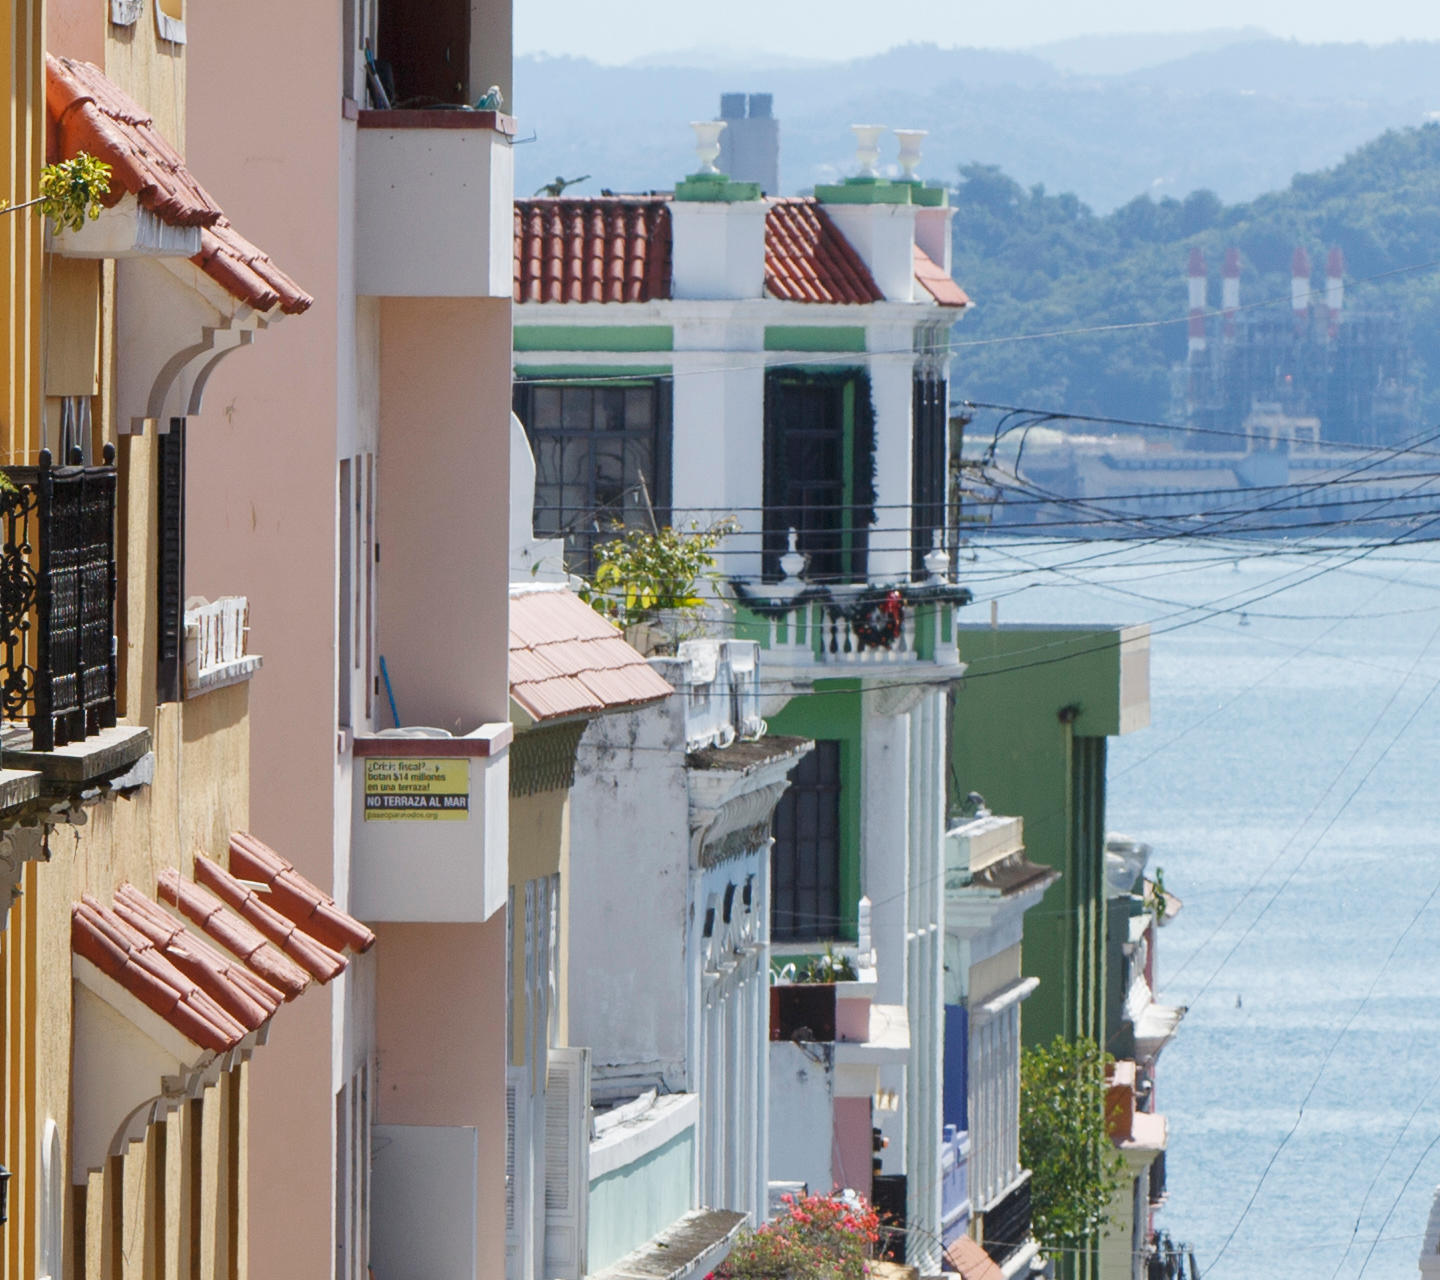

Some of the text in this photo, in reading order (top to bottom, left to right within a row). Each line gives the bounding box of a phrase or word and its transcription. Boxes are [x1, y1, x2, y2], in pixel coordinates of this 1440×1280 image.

[393, 772, 408, 782] $14
[411, 773, 446, 781] millones
[367, 782, 430, 791] en una terraza!
[367, 796, 466, 807] NO TERRAZA AL MAR
